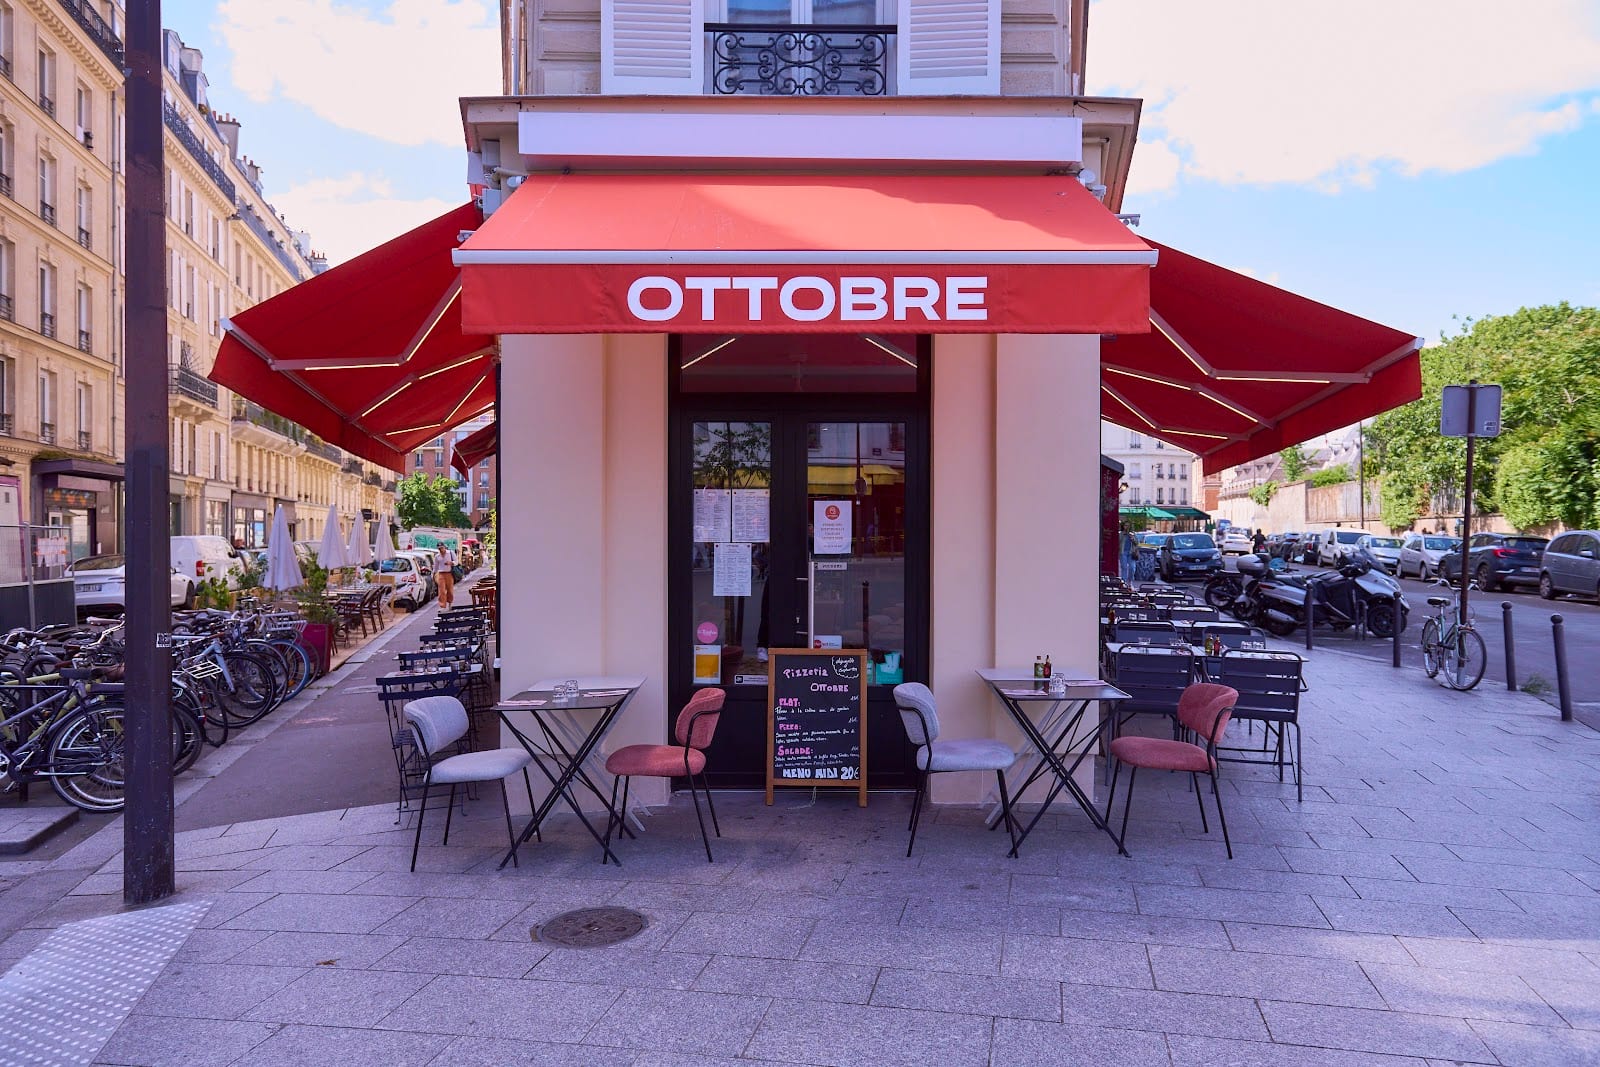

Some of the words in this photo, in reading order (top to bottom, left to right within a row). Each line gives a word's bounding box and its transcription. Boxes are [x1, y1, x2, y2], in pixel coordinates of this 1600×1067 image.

[627, 276, 988, 321] OTTOBRE
[783, 667, 828, 679] Pizzeria
[782, 768, 811, 779] MENU
[815, 767, 838, 779] MIDI
[840, 766, 860, 780] 20€
